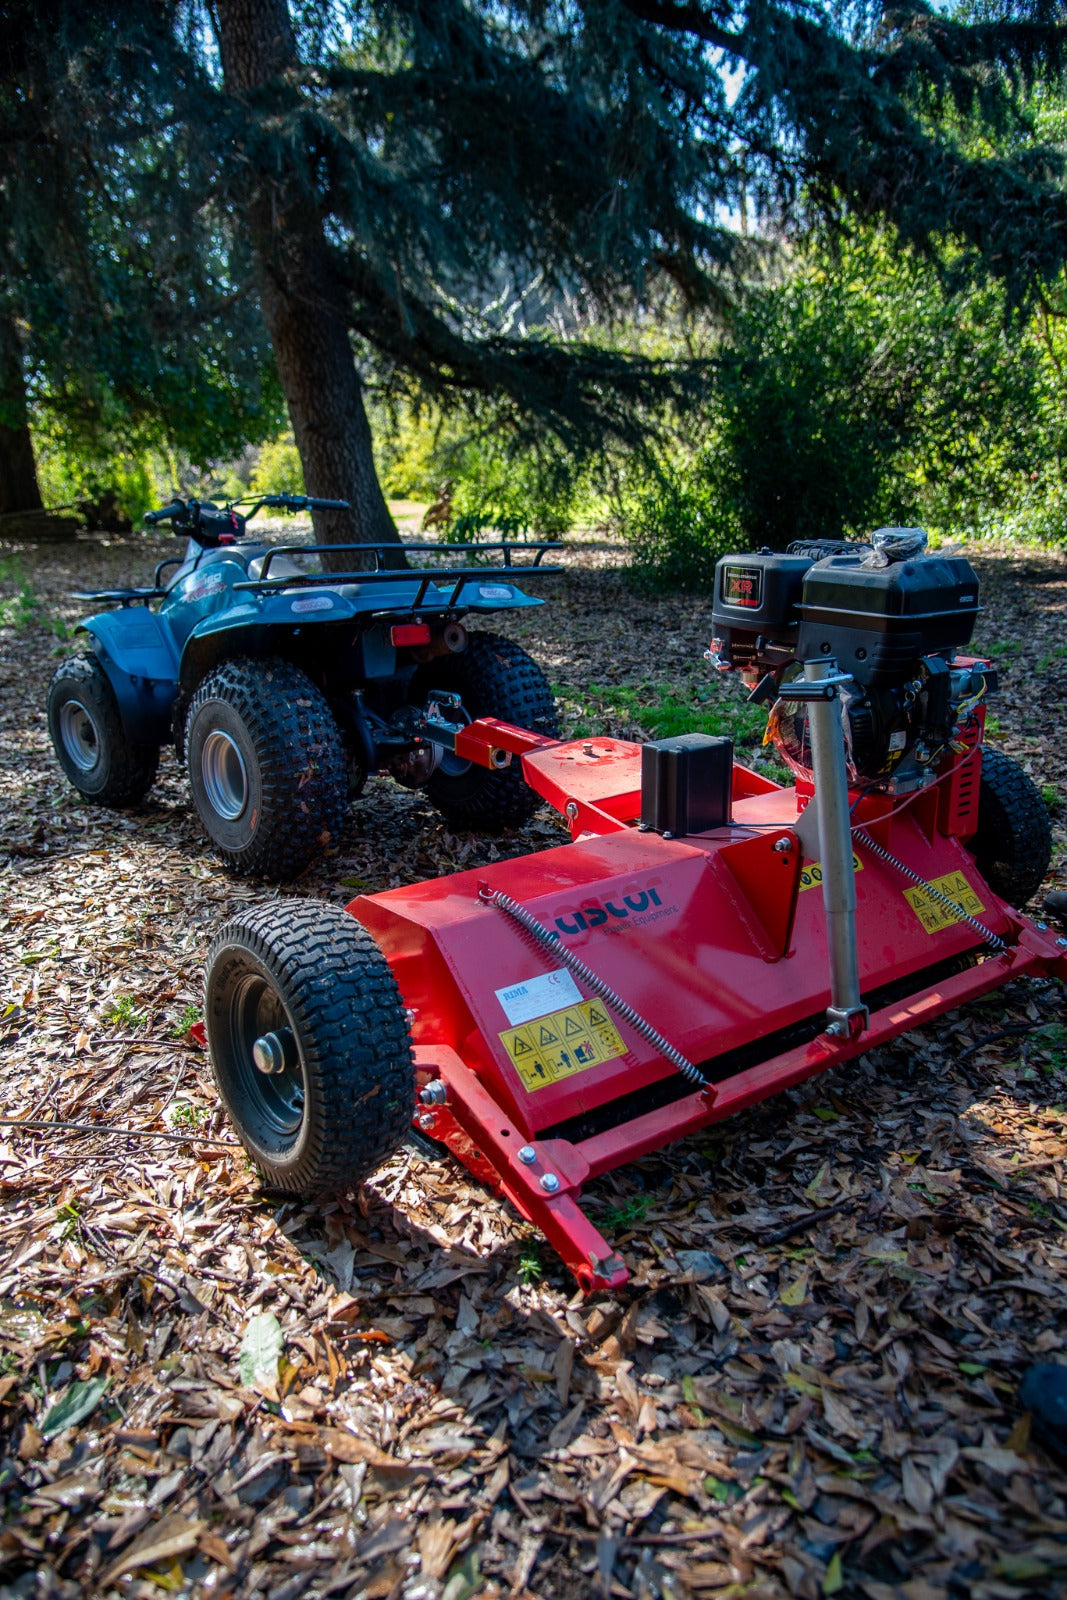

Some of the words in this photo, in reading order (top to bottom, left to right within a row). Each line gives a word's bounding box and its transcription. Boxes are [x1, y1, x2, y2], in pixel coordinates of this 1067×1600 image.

[730, 579, 753, 594] XR
[632, 904, 680, 928] Equipment
[502, 986, 528, 1001] RIMA
